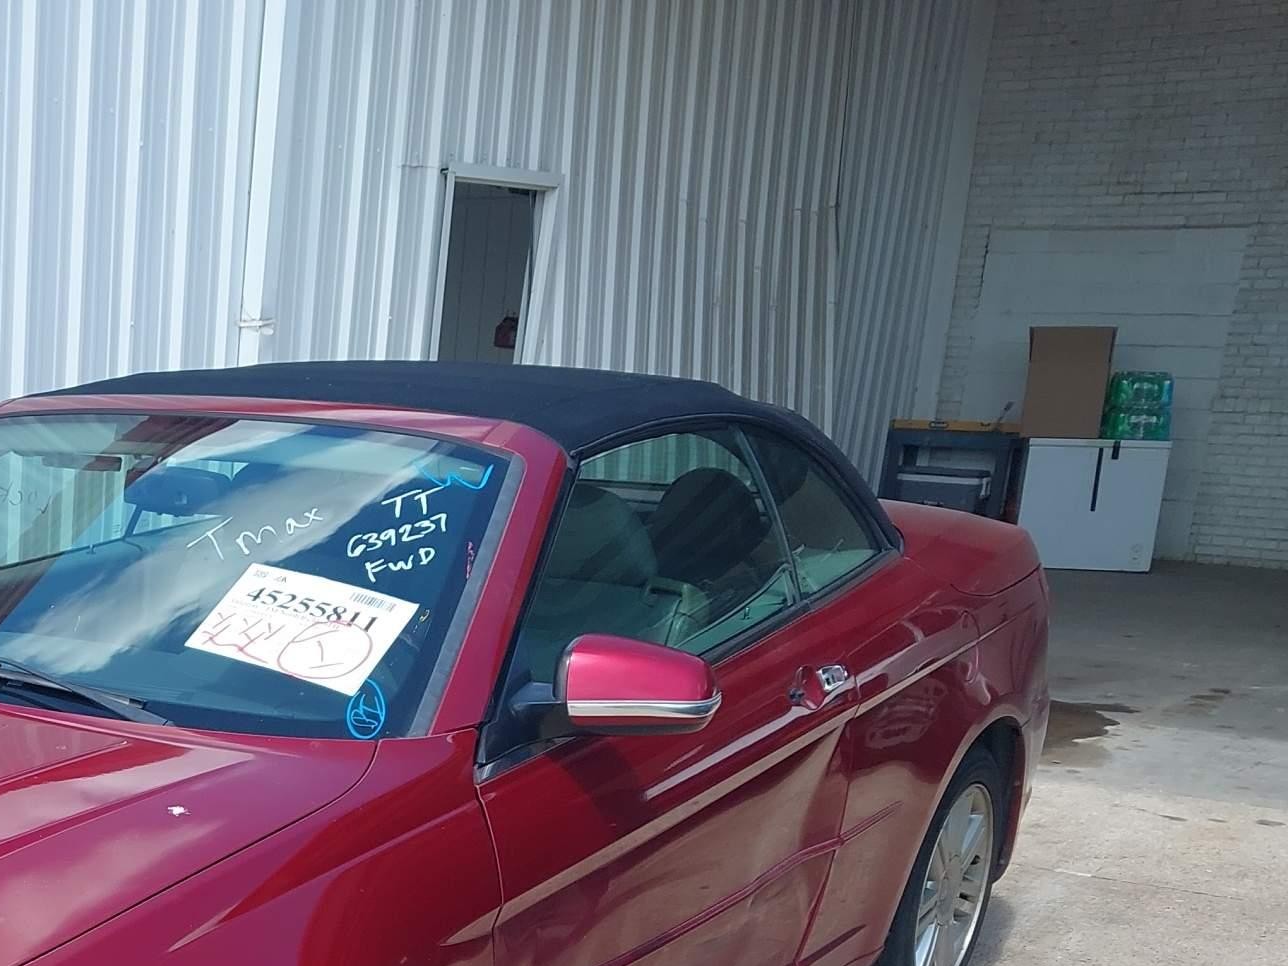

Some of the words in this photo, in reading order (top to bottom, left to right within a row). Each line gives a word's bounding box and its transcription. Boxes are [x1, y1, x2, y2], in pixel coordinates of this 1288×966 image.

[186, 508, 324, 560] Tmax
[347, 513, 448, 557] 639237
[364, 547, 436, 583] FWD
[247, 587, 379, 632] 45255811
